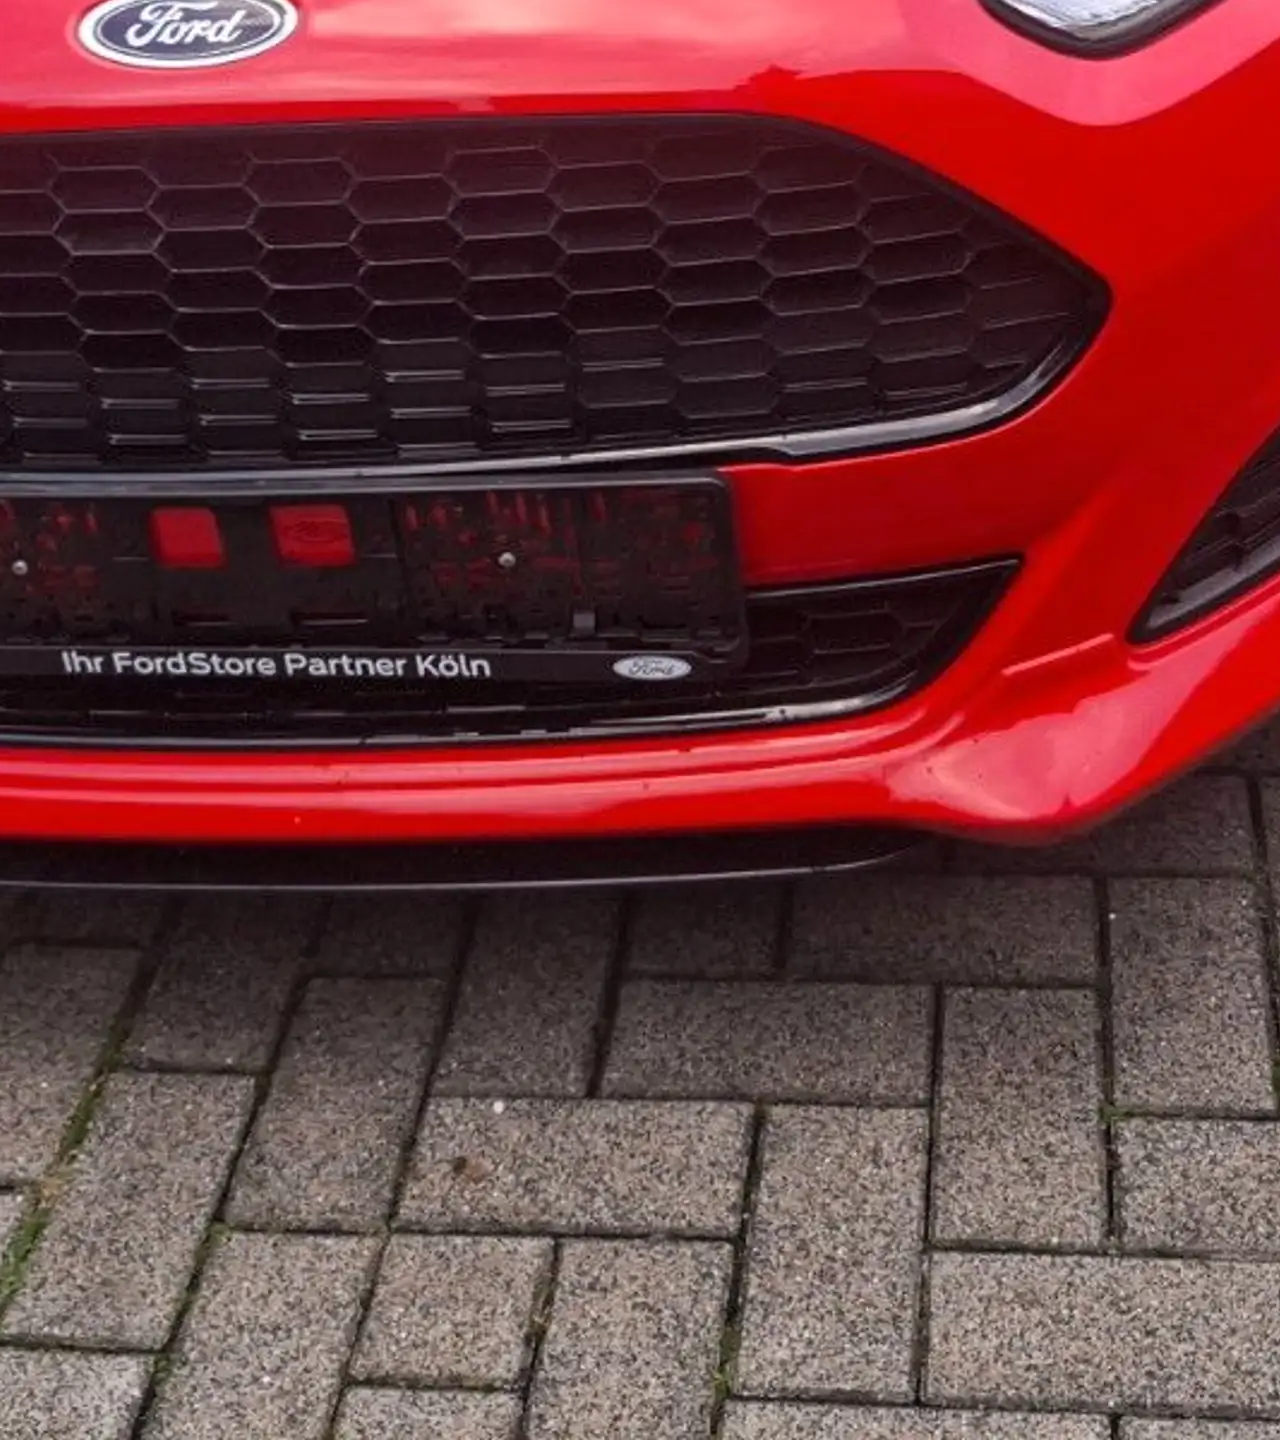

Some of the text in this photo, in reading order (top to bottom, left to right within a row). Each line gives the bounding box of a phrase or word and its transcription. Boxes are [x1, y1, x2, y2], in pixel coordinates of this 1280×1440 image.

[125, 0, 247, 47] Ford
[61, 650, 492, 678] Ihr FordStore Partner Köln
